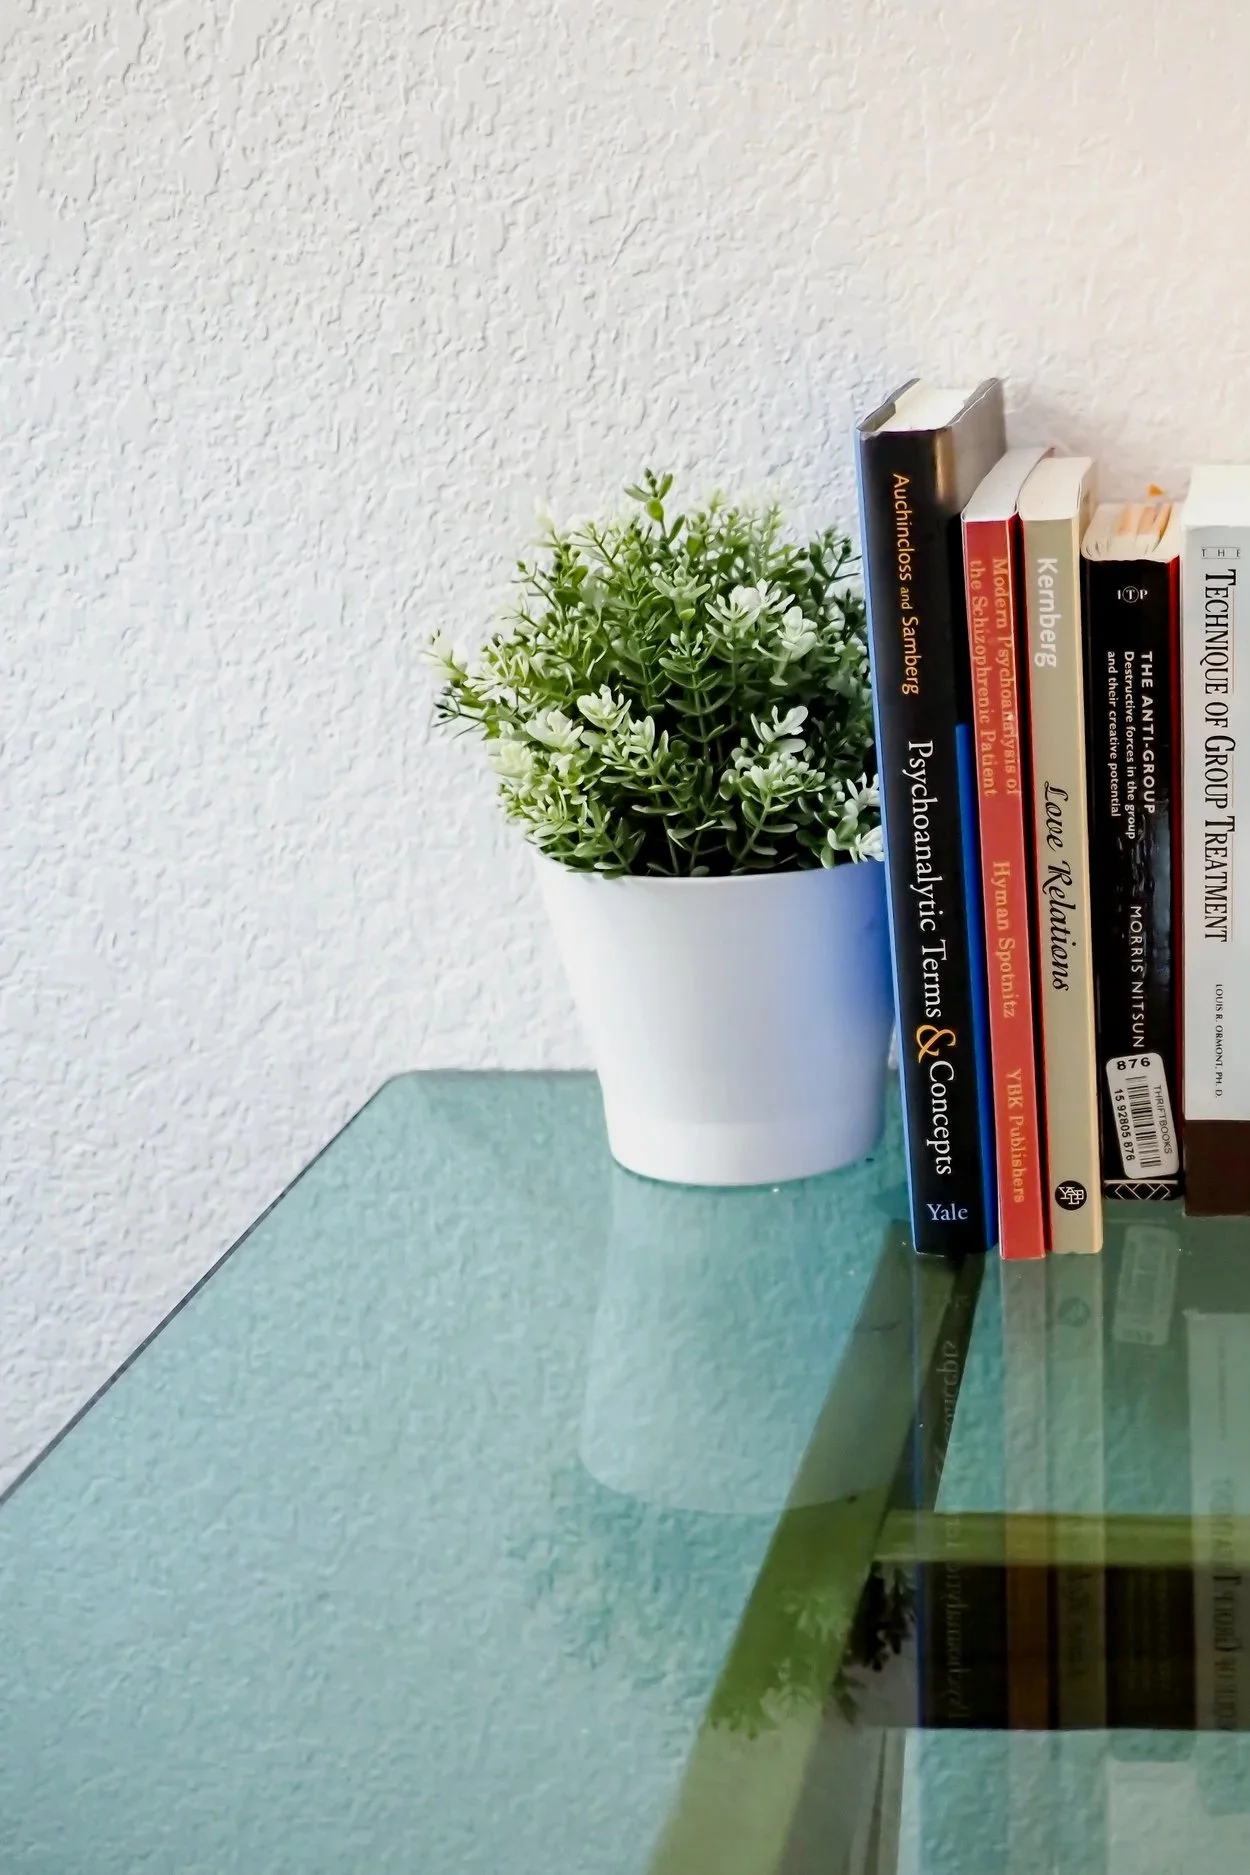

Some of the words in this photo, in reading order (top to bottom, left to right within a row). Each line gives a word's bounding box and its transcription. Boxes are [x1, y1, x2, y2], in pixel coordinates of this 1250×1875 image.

[892, 473, 915, 581] Auchincloss
[900, 587, 914, 610] and
[969, 559, 985, 590] the
[1034, 557, 1059, 668] Kernberg
[901, 617, 923, 695] Samberg
[971, 596, 994, 724] Schizophrenic
[992, 558, 1012, 629] Modern
[1006, 779, 1022, 795] of
[1107, 652, 1118, 674] and
[1140, 651, 1154, 688] THE
[1108, 677, 1119, 707] their
[1124, 651, 1135, 723] Destructive
[1108, 711, 1120, 760] creative
[1126, 725, 1136, 763] forces
[1141, 695, 1155, 814] ANTI-GROUP
[980, 731, 998, 796] Patient
[1107, 763, 1121, 817] potential
[1126, 766, 1136, 777] in
[1127, 779, 1137, 801] the
[902, 740, 944, 932] Psychoanalytic
[1044, 780, 1069, 852] Love
[1125, 804, 1136, 840] group
[991, 861, 1011, 930] Hyman
[1042, 860, 1077, 991] Relations
[1130, 906, 1144, 973] MORRIS
[921, 939, 947, 1018] Terms
[995, 937, 1019, 1018] Spotnitz
[1215, 984, 1223, 1011] LOUIS
[1131, 982, 1145, 1048] NITSUN
[1215, 1013, 1223, 1022] R.
[915, 1024, 956, 1063] &
[1116, 1057, 1151, 1071] 876
[1006, 1068, 1024, 1108] YBK
[1114, 1088, 1125, 1101] 15
[926, 1060, 955, 1175] Concepts
[1117, 1105, 1132, 1138] 92805
[1153, 1085, 1173, 1154] THRIFTBOOKS
[1008, 1115, 1028, 1204] Publishers
[1124, 1142, 1136, 1161] 876
[926, 1203, 969, 1221] Yale
